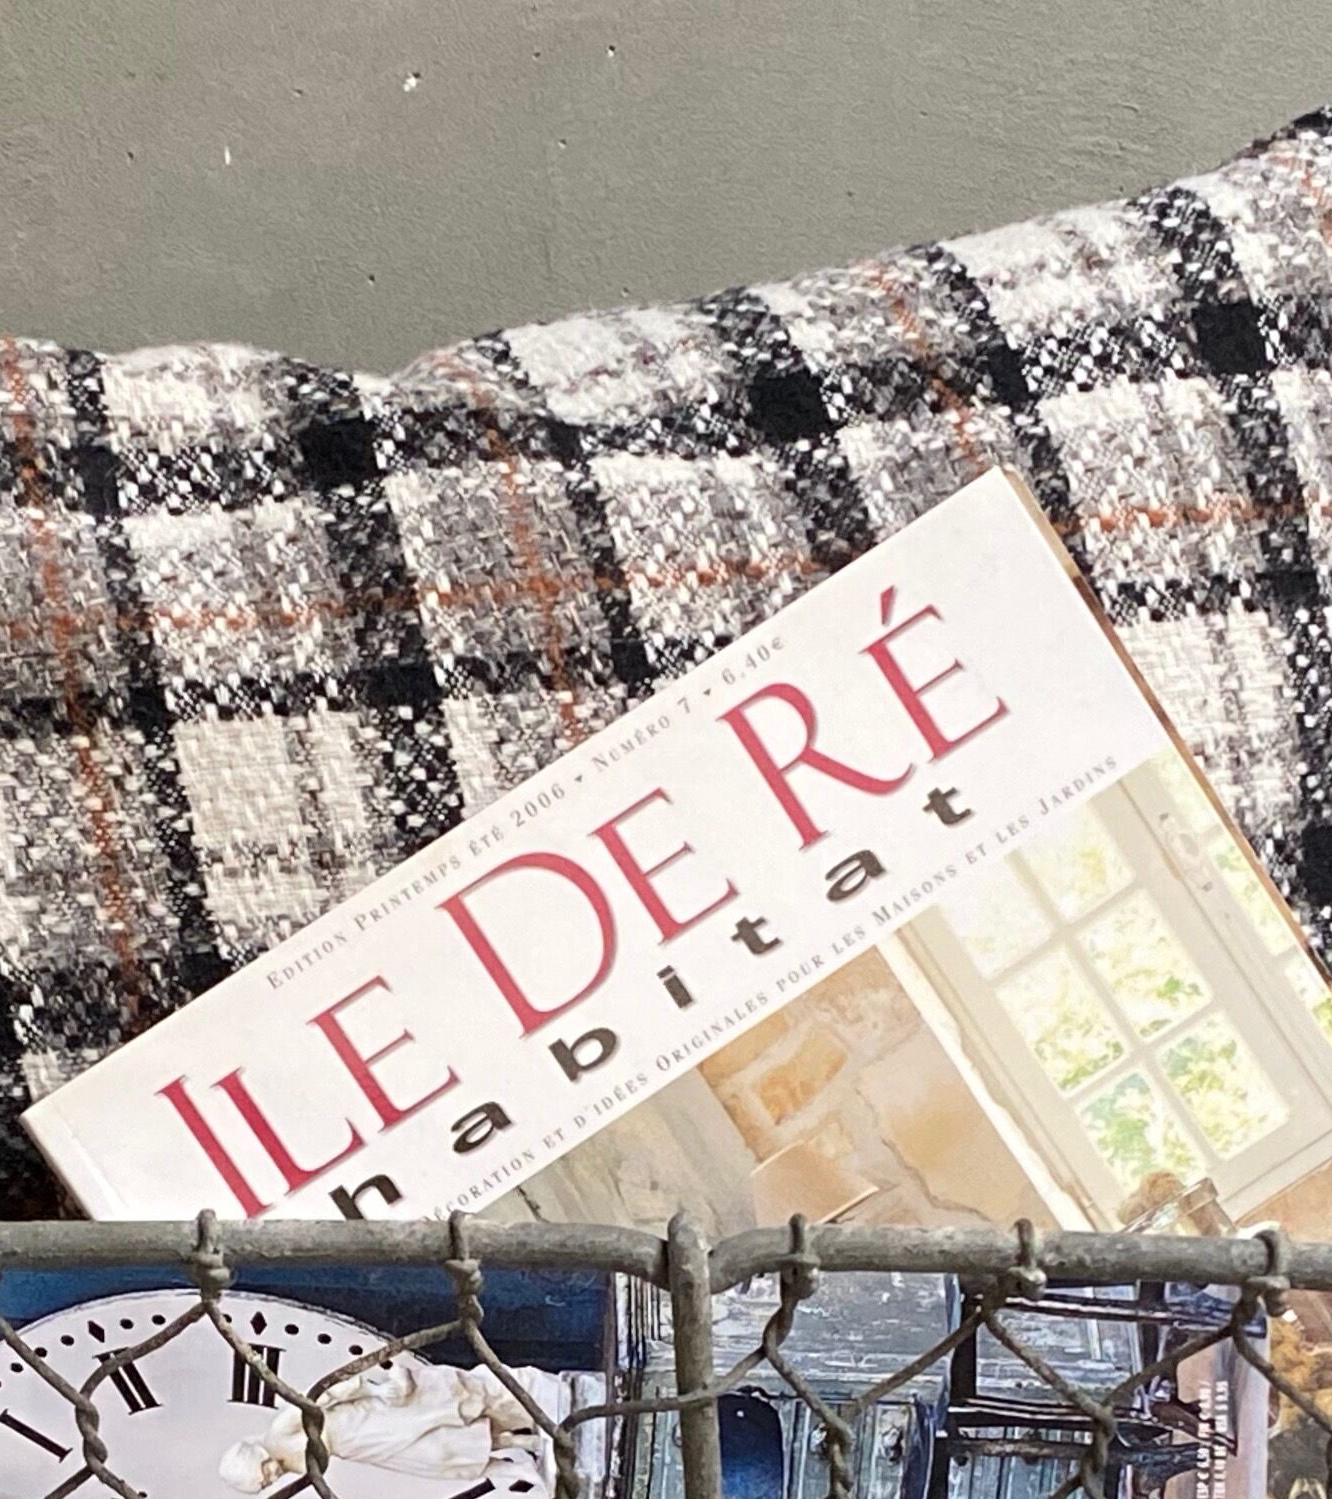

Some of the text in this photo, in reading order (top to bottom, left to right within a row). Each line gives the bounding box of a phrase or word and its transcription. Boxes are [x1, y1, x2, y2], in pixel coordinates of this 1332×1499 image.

[155, 588, 1007, 1220] ILE DE RÉ
[509, 782, 566, 828] 2006
[675, 688, 693, 714] 7
[327, 786, 973, 1221] habitat
